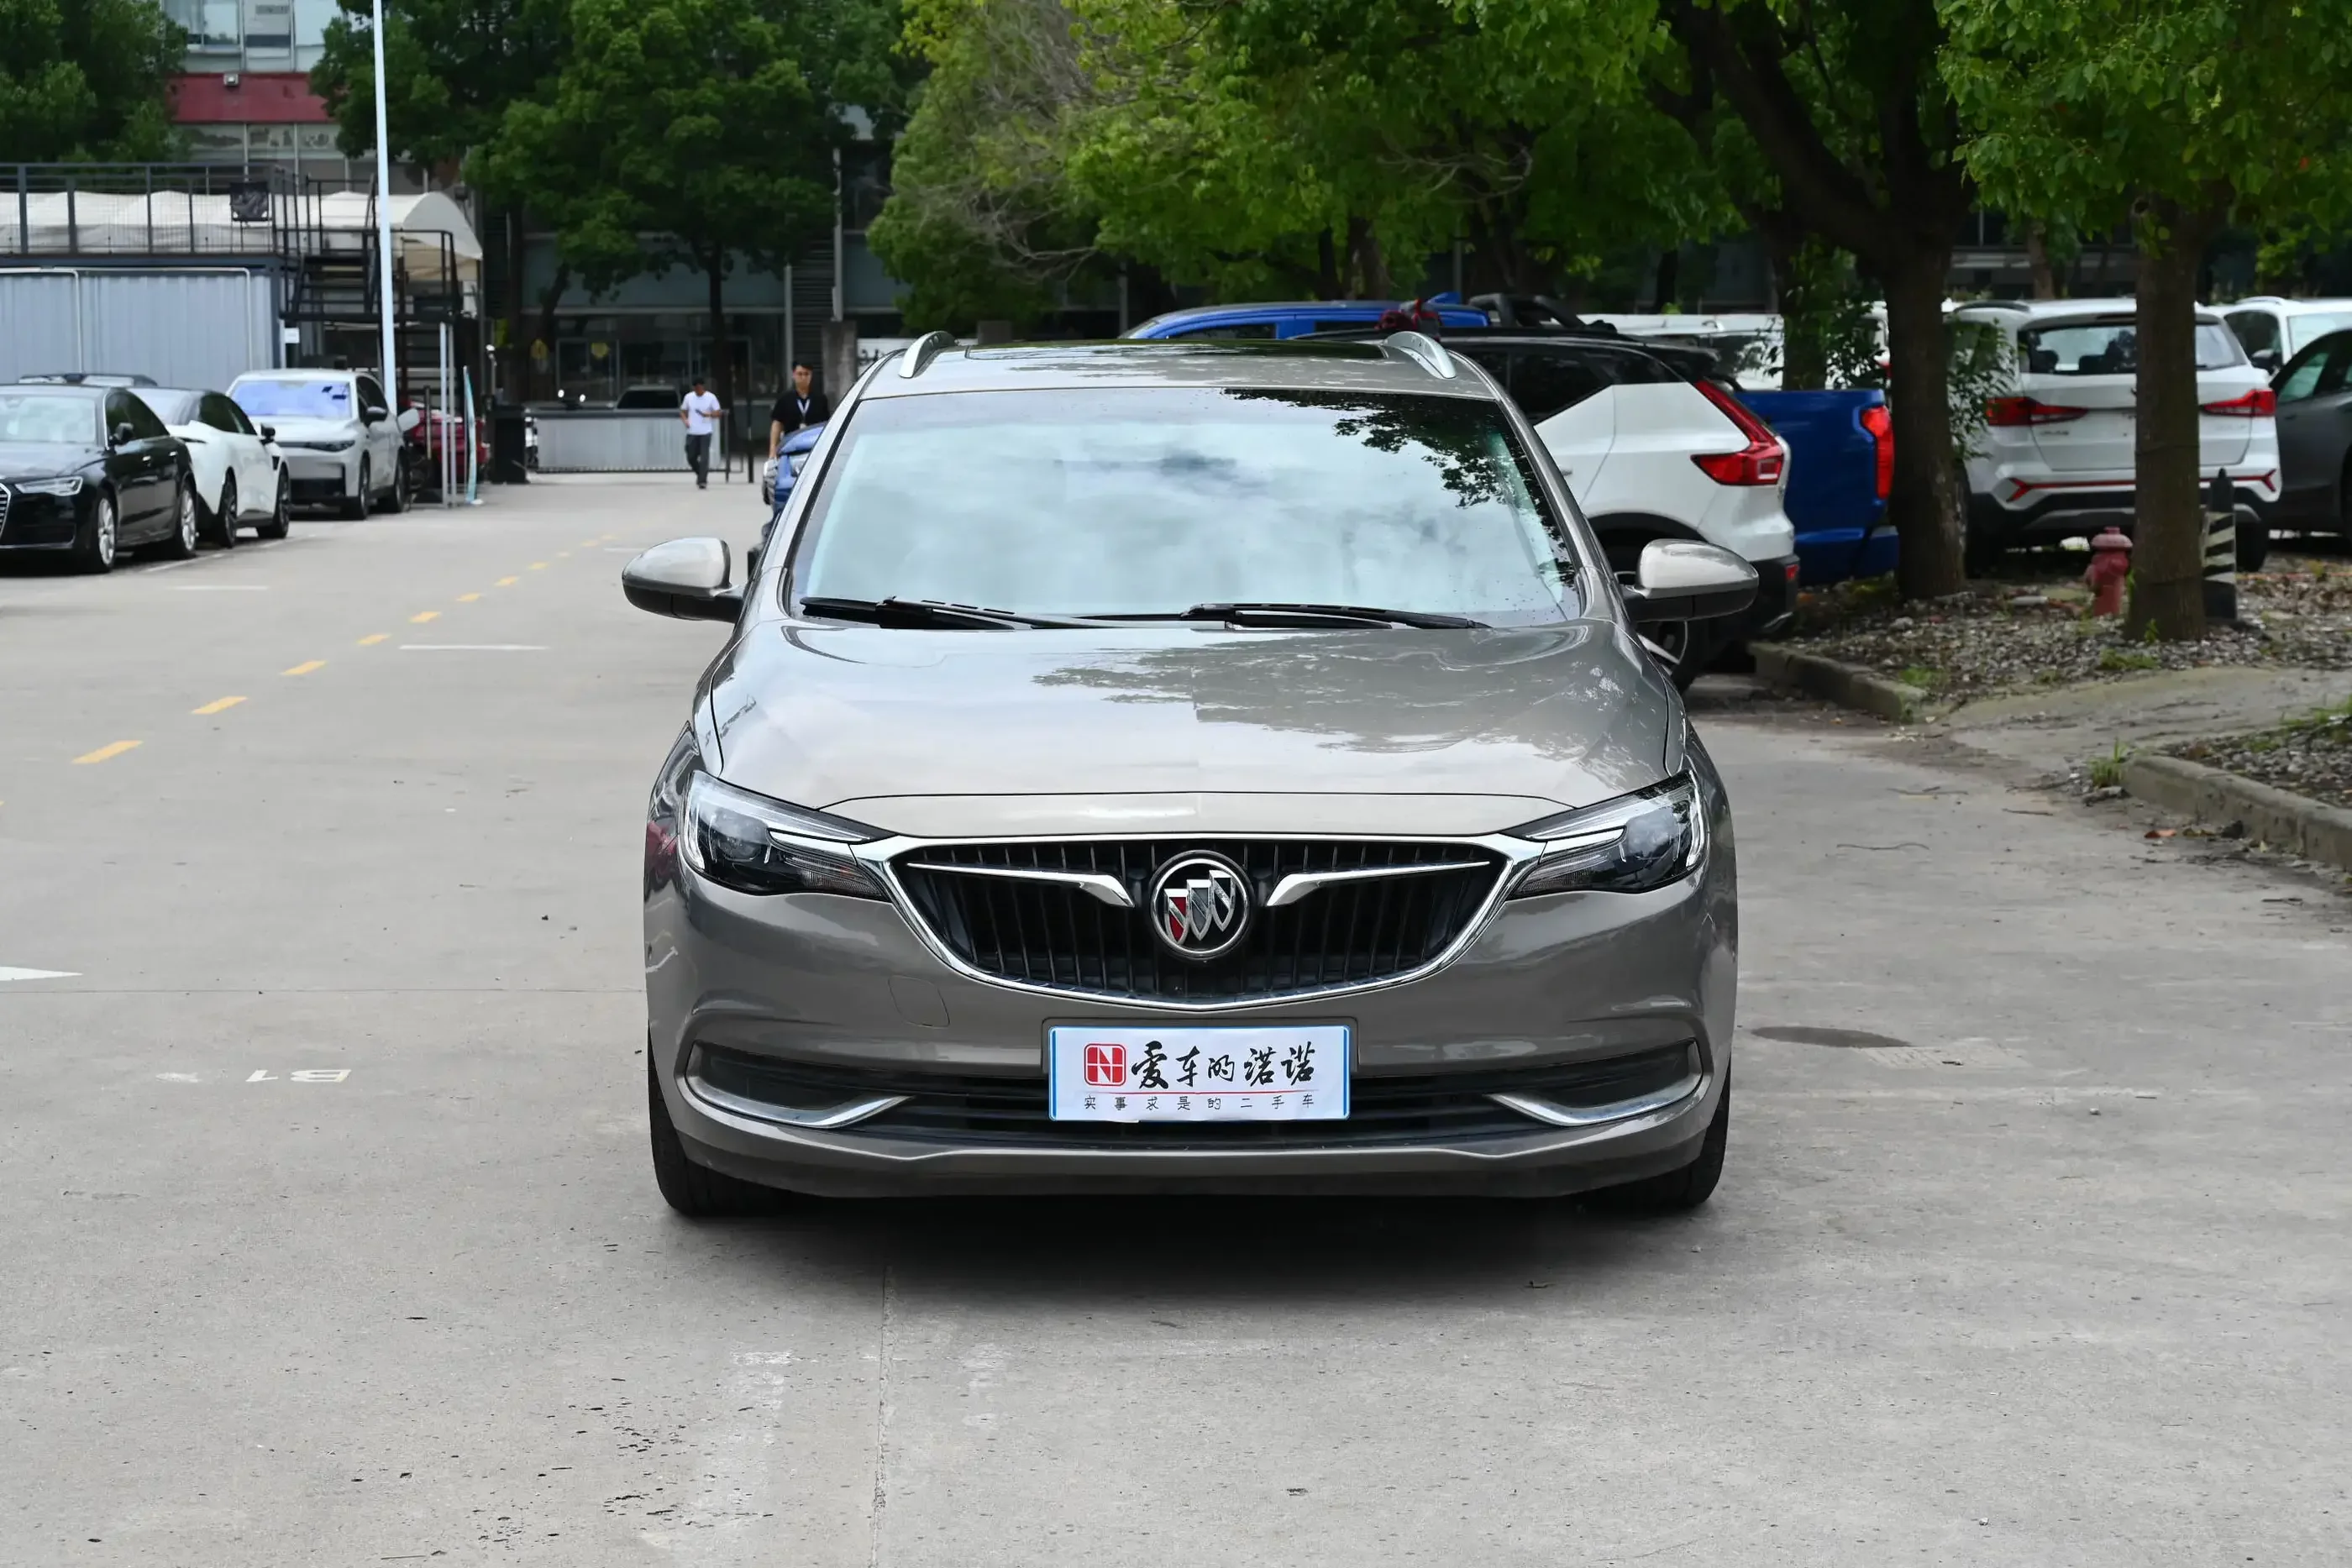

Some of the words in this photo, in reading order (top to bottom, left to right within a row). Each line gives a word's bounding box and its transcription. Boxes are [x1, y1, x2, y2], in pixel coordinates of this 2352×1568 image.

[1084, 1093, 1315, 1111] 实事求是的二手车
